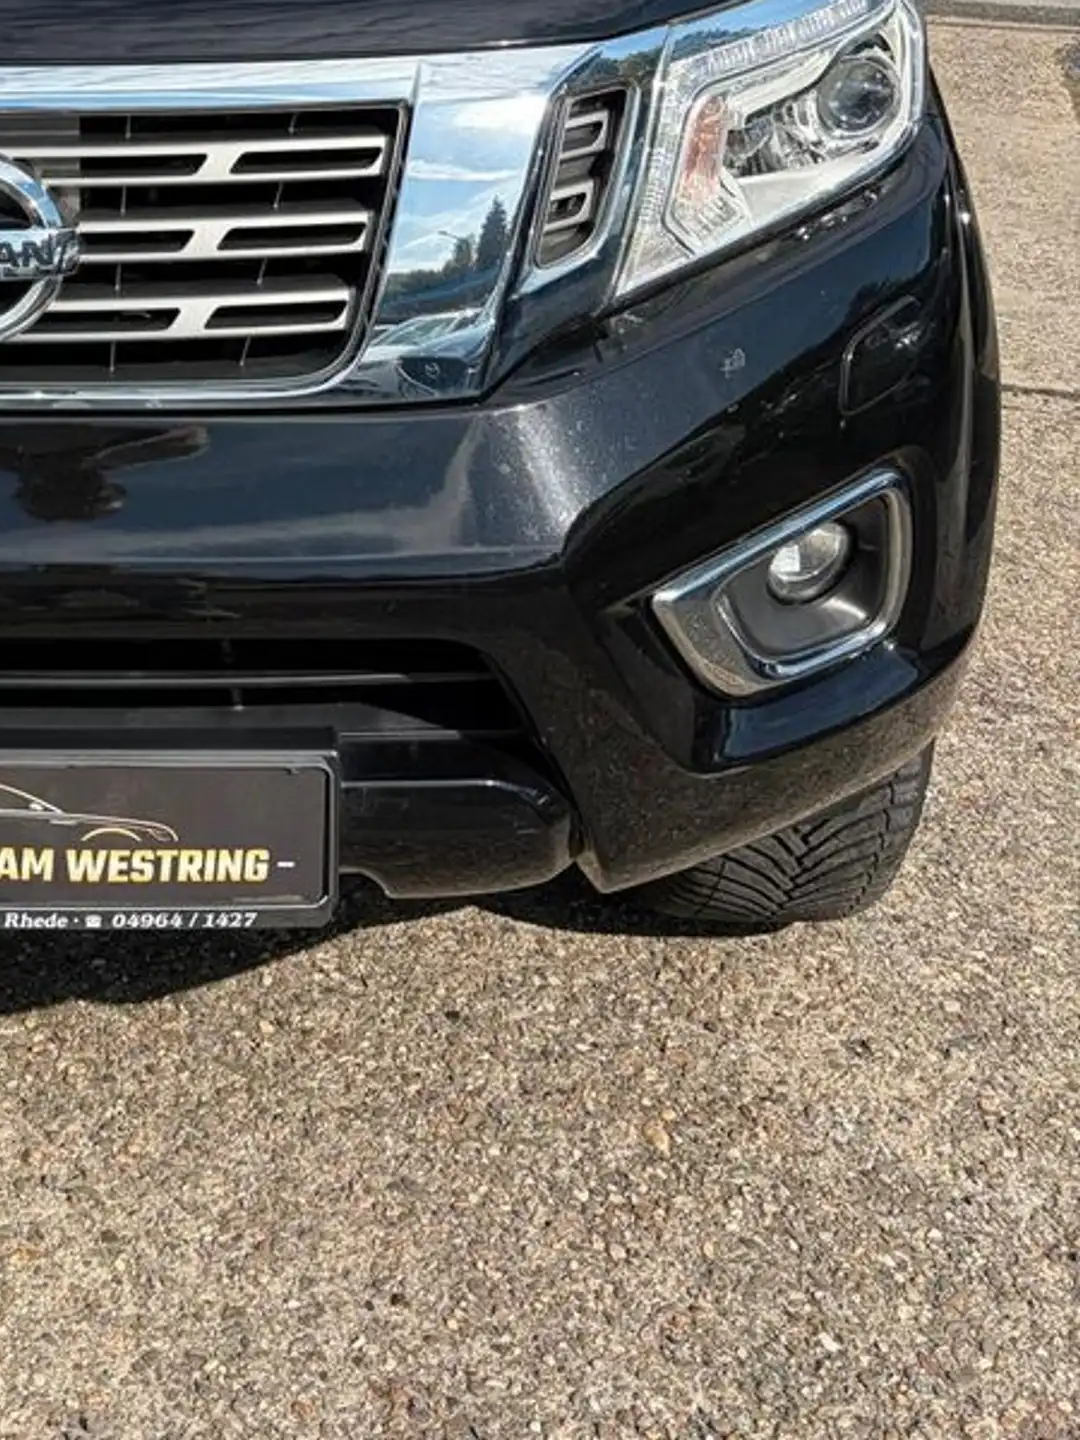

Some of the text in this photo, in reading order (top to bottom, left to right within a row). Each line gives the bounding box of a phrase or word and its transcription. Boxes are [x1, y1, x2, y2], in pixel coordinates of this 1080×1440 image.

[66, 848, 271, 883] WESTRING
[4, 912, 69, 928] Rhede
[112, 913, 183, 929] 04964
[202, 912, 259, 928] 1427
